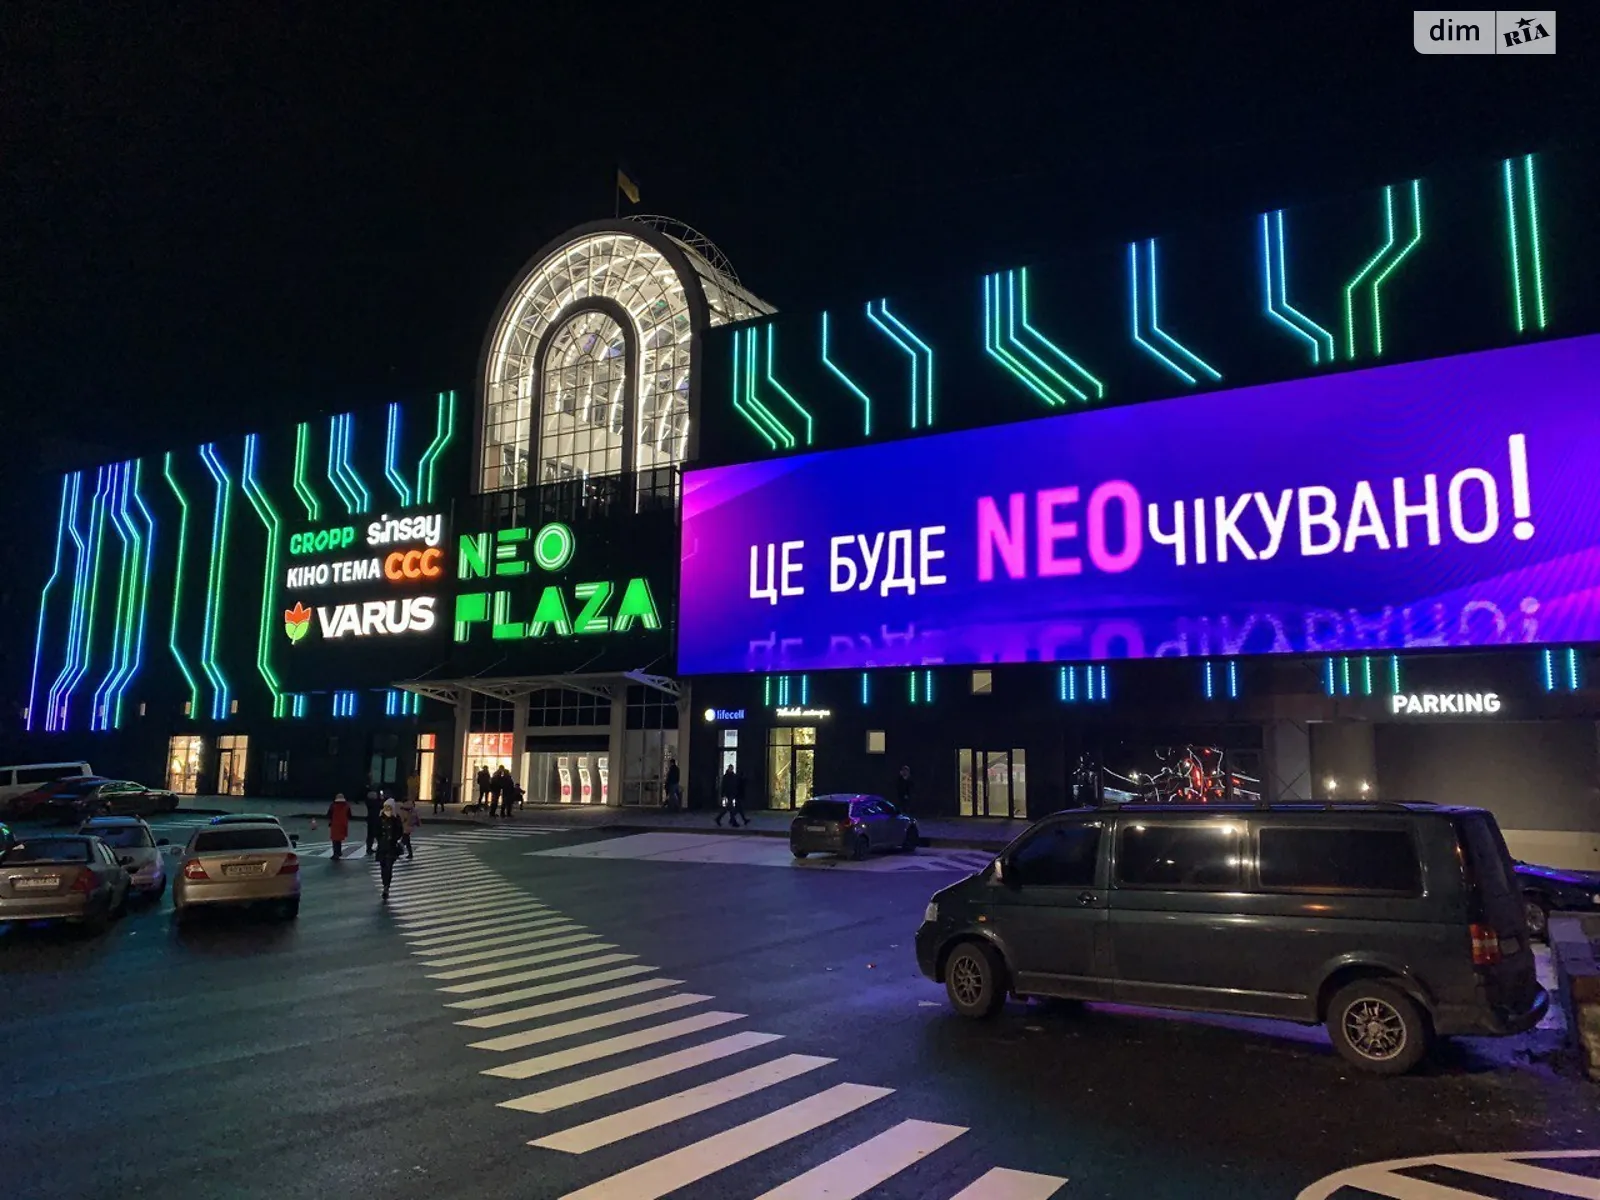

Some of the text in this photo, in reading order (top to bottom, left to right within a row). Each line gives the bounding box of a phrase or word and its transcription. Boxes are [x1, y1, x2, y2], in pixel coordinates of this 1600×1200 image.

[289, 526, 355, 555] CROPP
[366, 513, 442, 546] sinsay
[383, 547, 443, 580] CCC
[457, 522, 575, 580] NEO
[749, 540, 804, 605] ЦЕ
[829, 525, 947, 597] БУДЕ
[316, 596, 436, 639] VARUS
[454, 577, 661, 643] PLAZA
[716, 709, 745, 720] lifecell
[1392, 693, 1501, 714] PARKING
